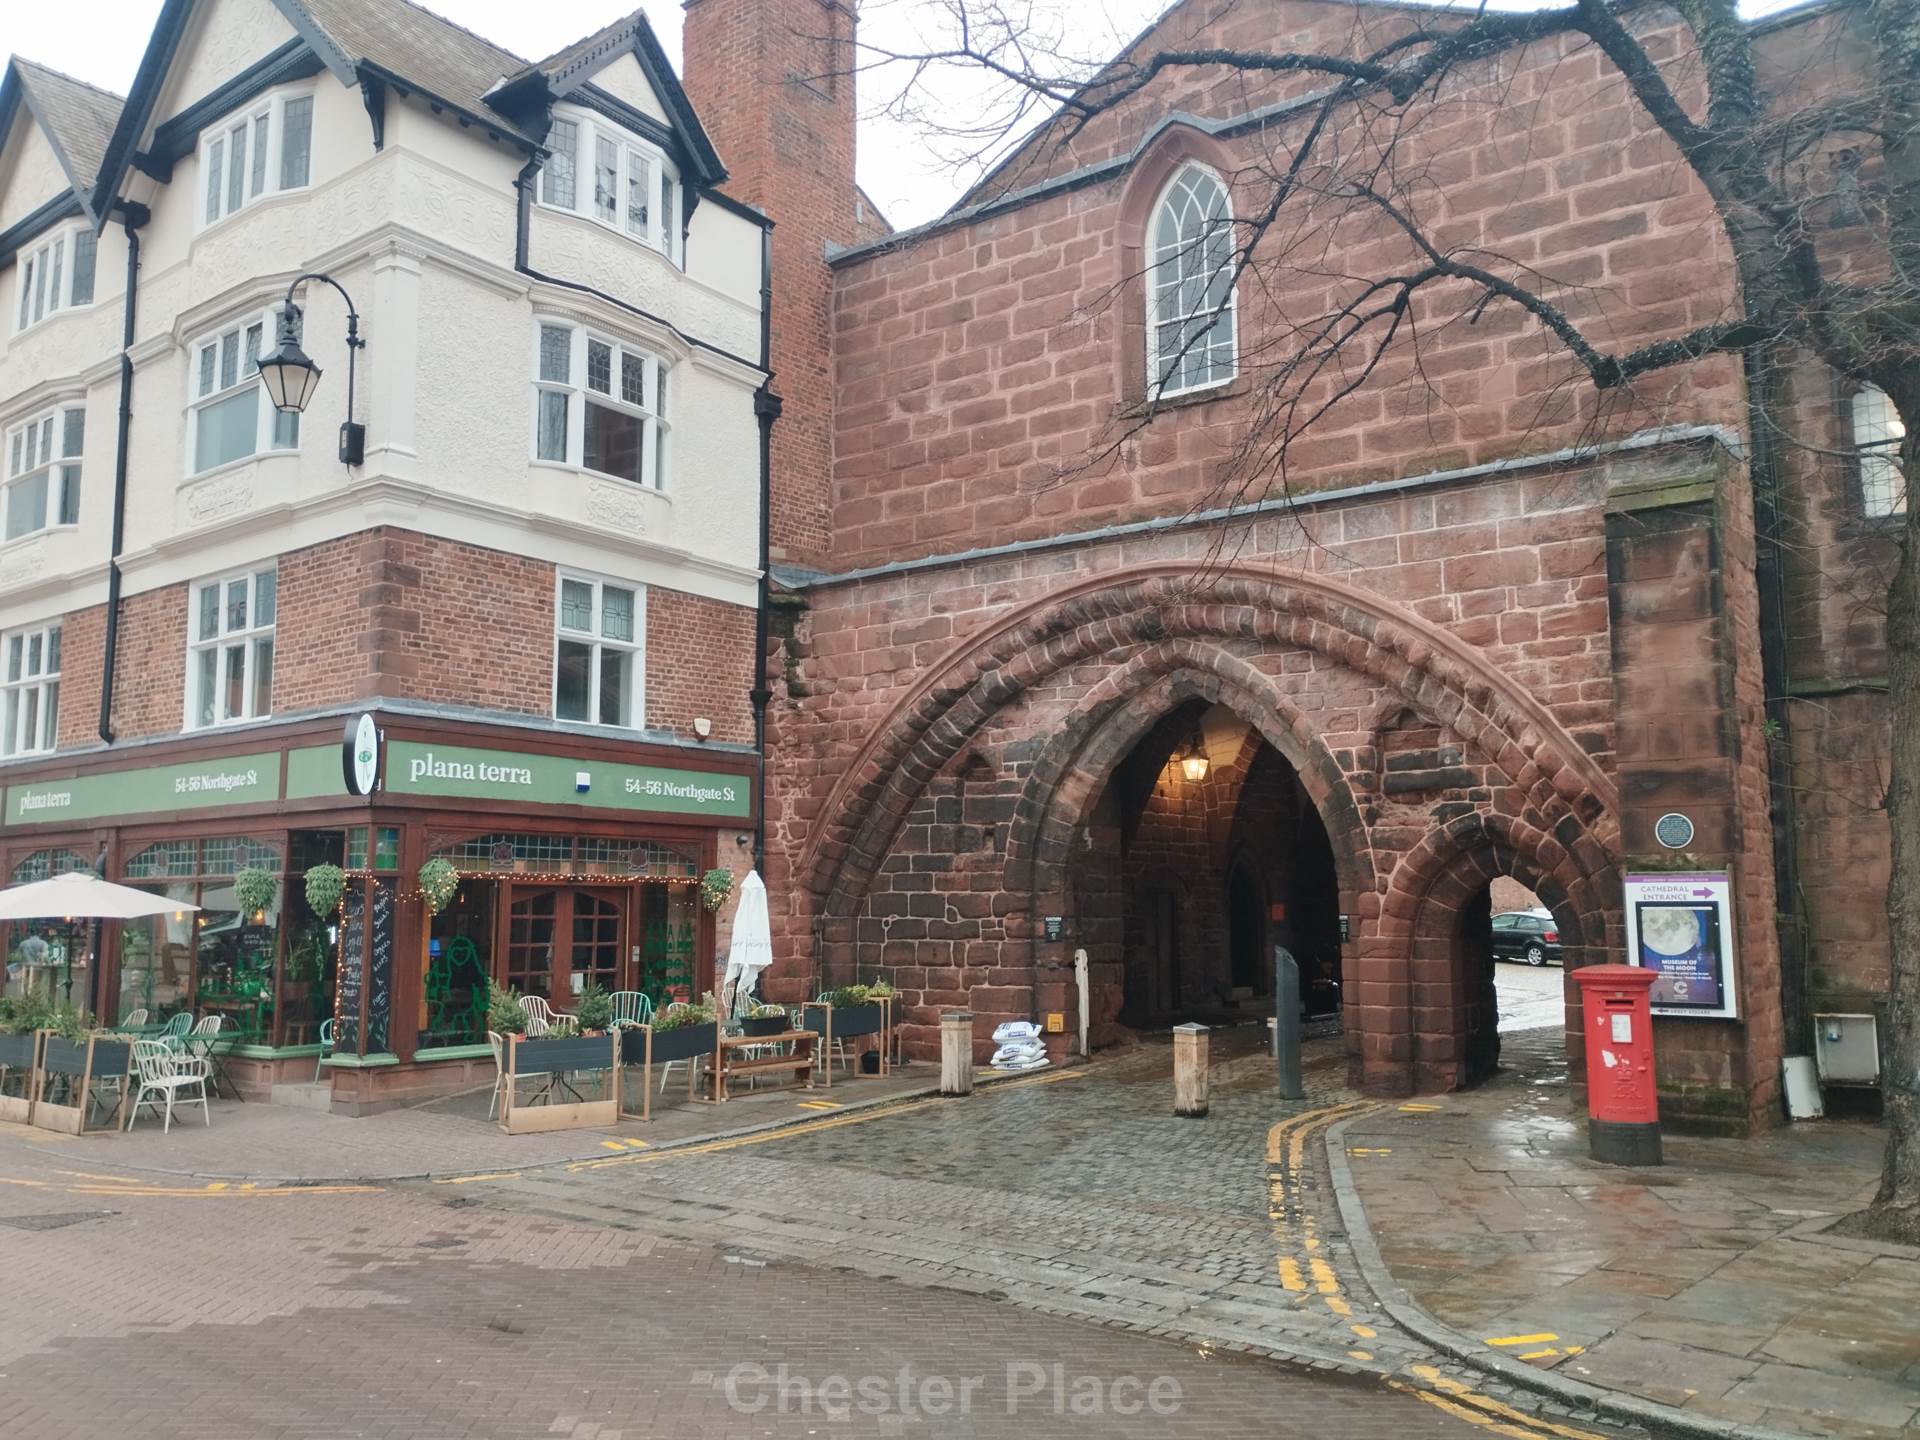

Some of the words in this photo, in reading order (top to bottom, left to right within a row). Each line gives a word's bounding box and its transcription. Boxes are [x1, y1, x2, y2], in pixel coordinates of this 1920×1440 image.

[175, 776, 200, 793] 54-56
[201, 773, 246, 792] Northgate
[247, 769, 257, 786] St
[410, 753, 478, 782] plana
[479, 760, 532, 785] terra
[20, 790, 47, 815] plana
[47, 791, 71, 809] terra
[625, 778, 662, 796] 54-56
[663, 782, 722, 803] Northgate
[723, 786, 735, 801] St
[1640, 885, 1690, 893] CATHEDRAL
